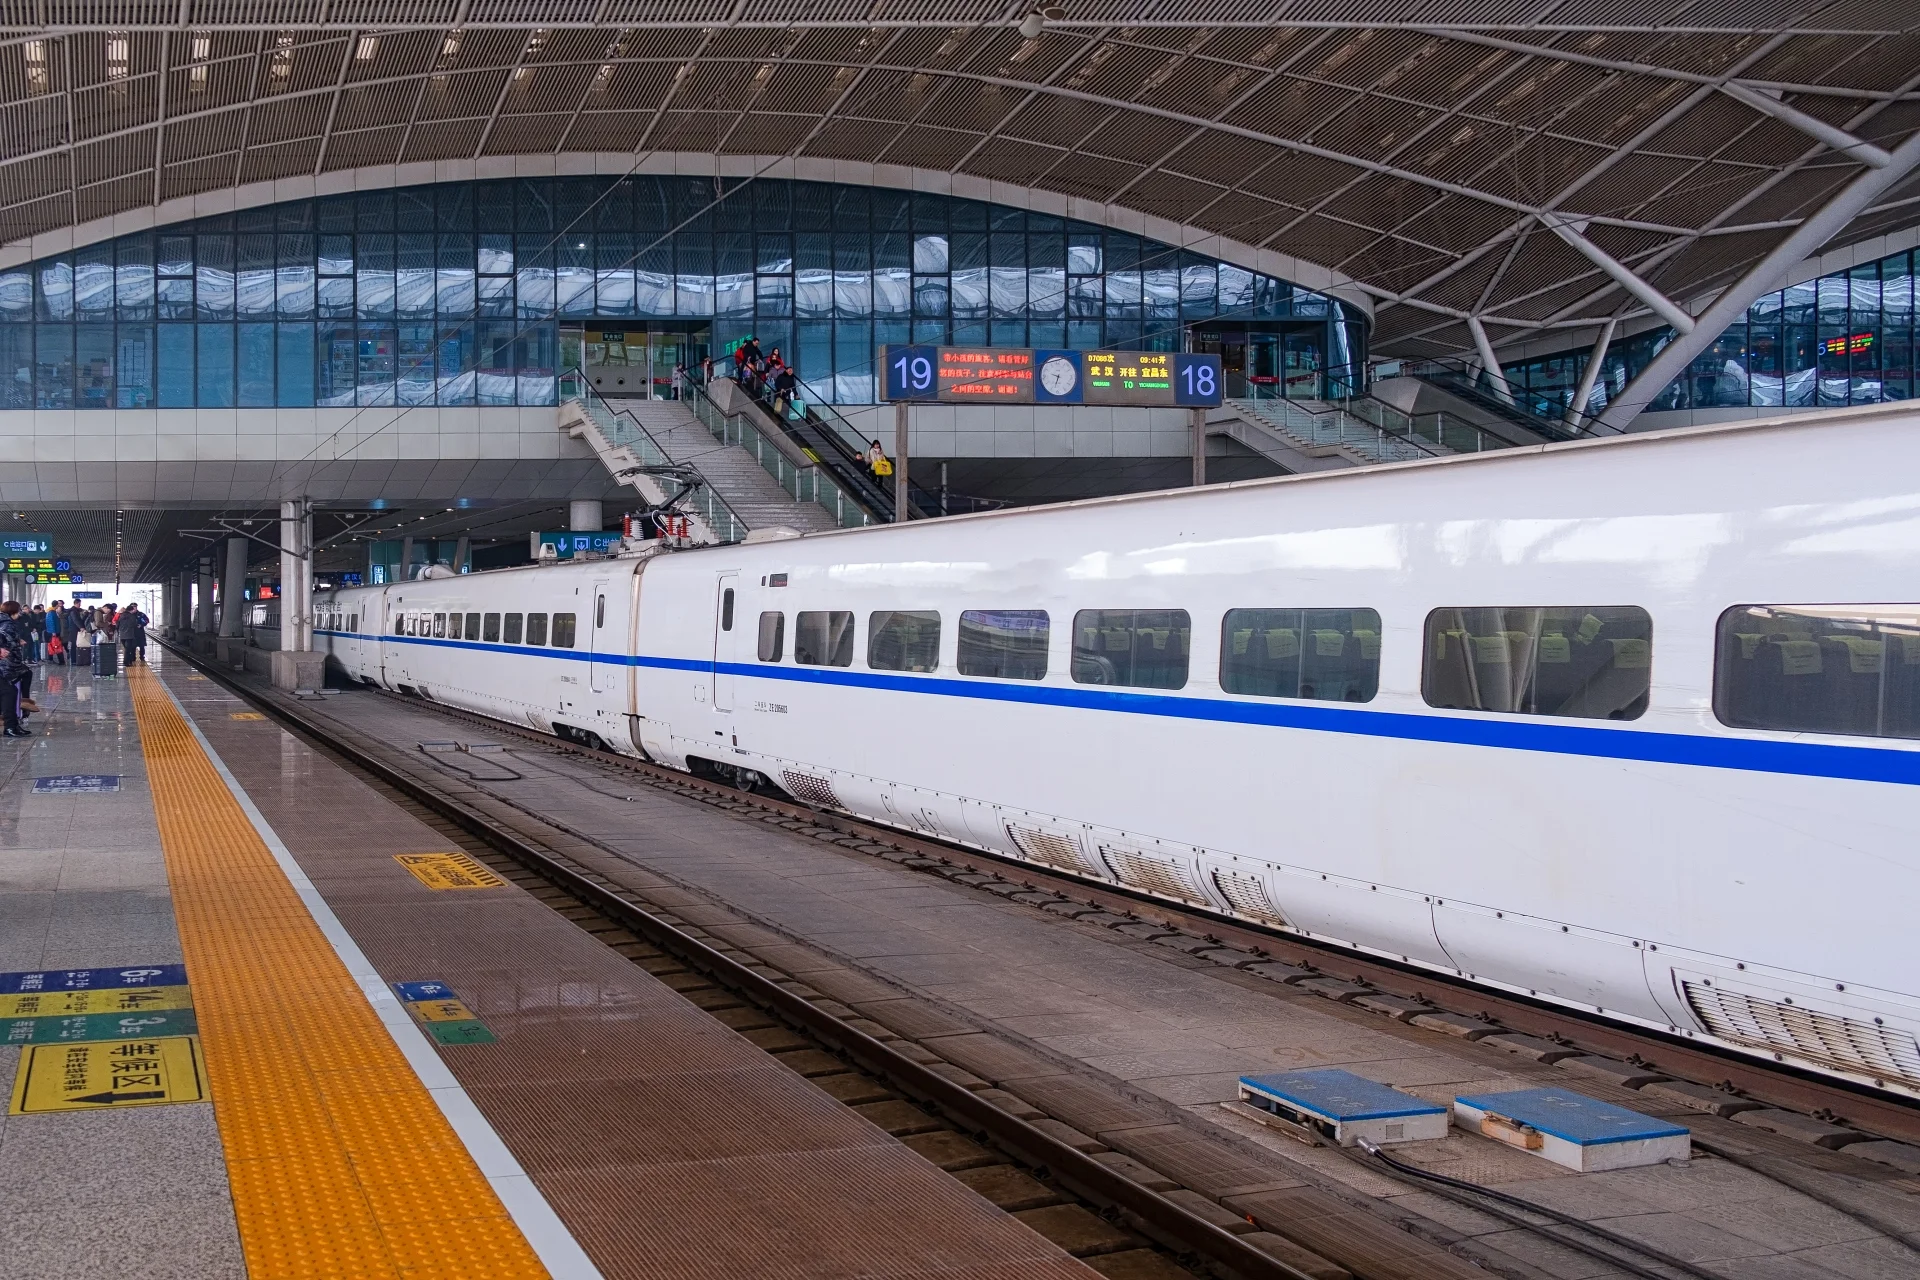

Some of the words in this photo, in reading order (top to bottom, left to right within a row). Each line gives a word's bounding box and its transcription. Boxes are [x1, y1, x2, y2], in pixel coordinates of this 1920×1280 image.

[894, 356, 931, 390] 19
[1141, 367, 1168, 378] 宜昌东
[1181, 364, 1215, 396] 18
[1123, 380, 1134, 389] TO
[57, 562, 69, 571] 20
[72, 575, 82, 583] 20
[20, 973, 44, 990] 等候区
[119, 969, 163, 984] 6车
[15, 996, 40, 1014] 等候区
[116, 989, 164, 1010] 14车
[114, 1016, 167, 1034] 3车
[109, 1043, 161, 1090] 等候区
